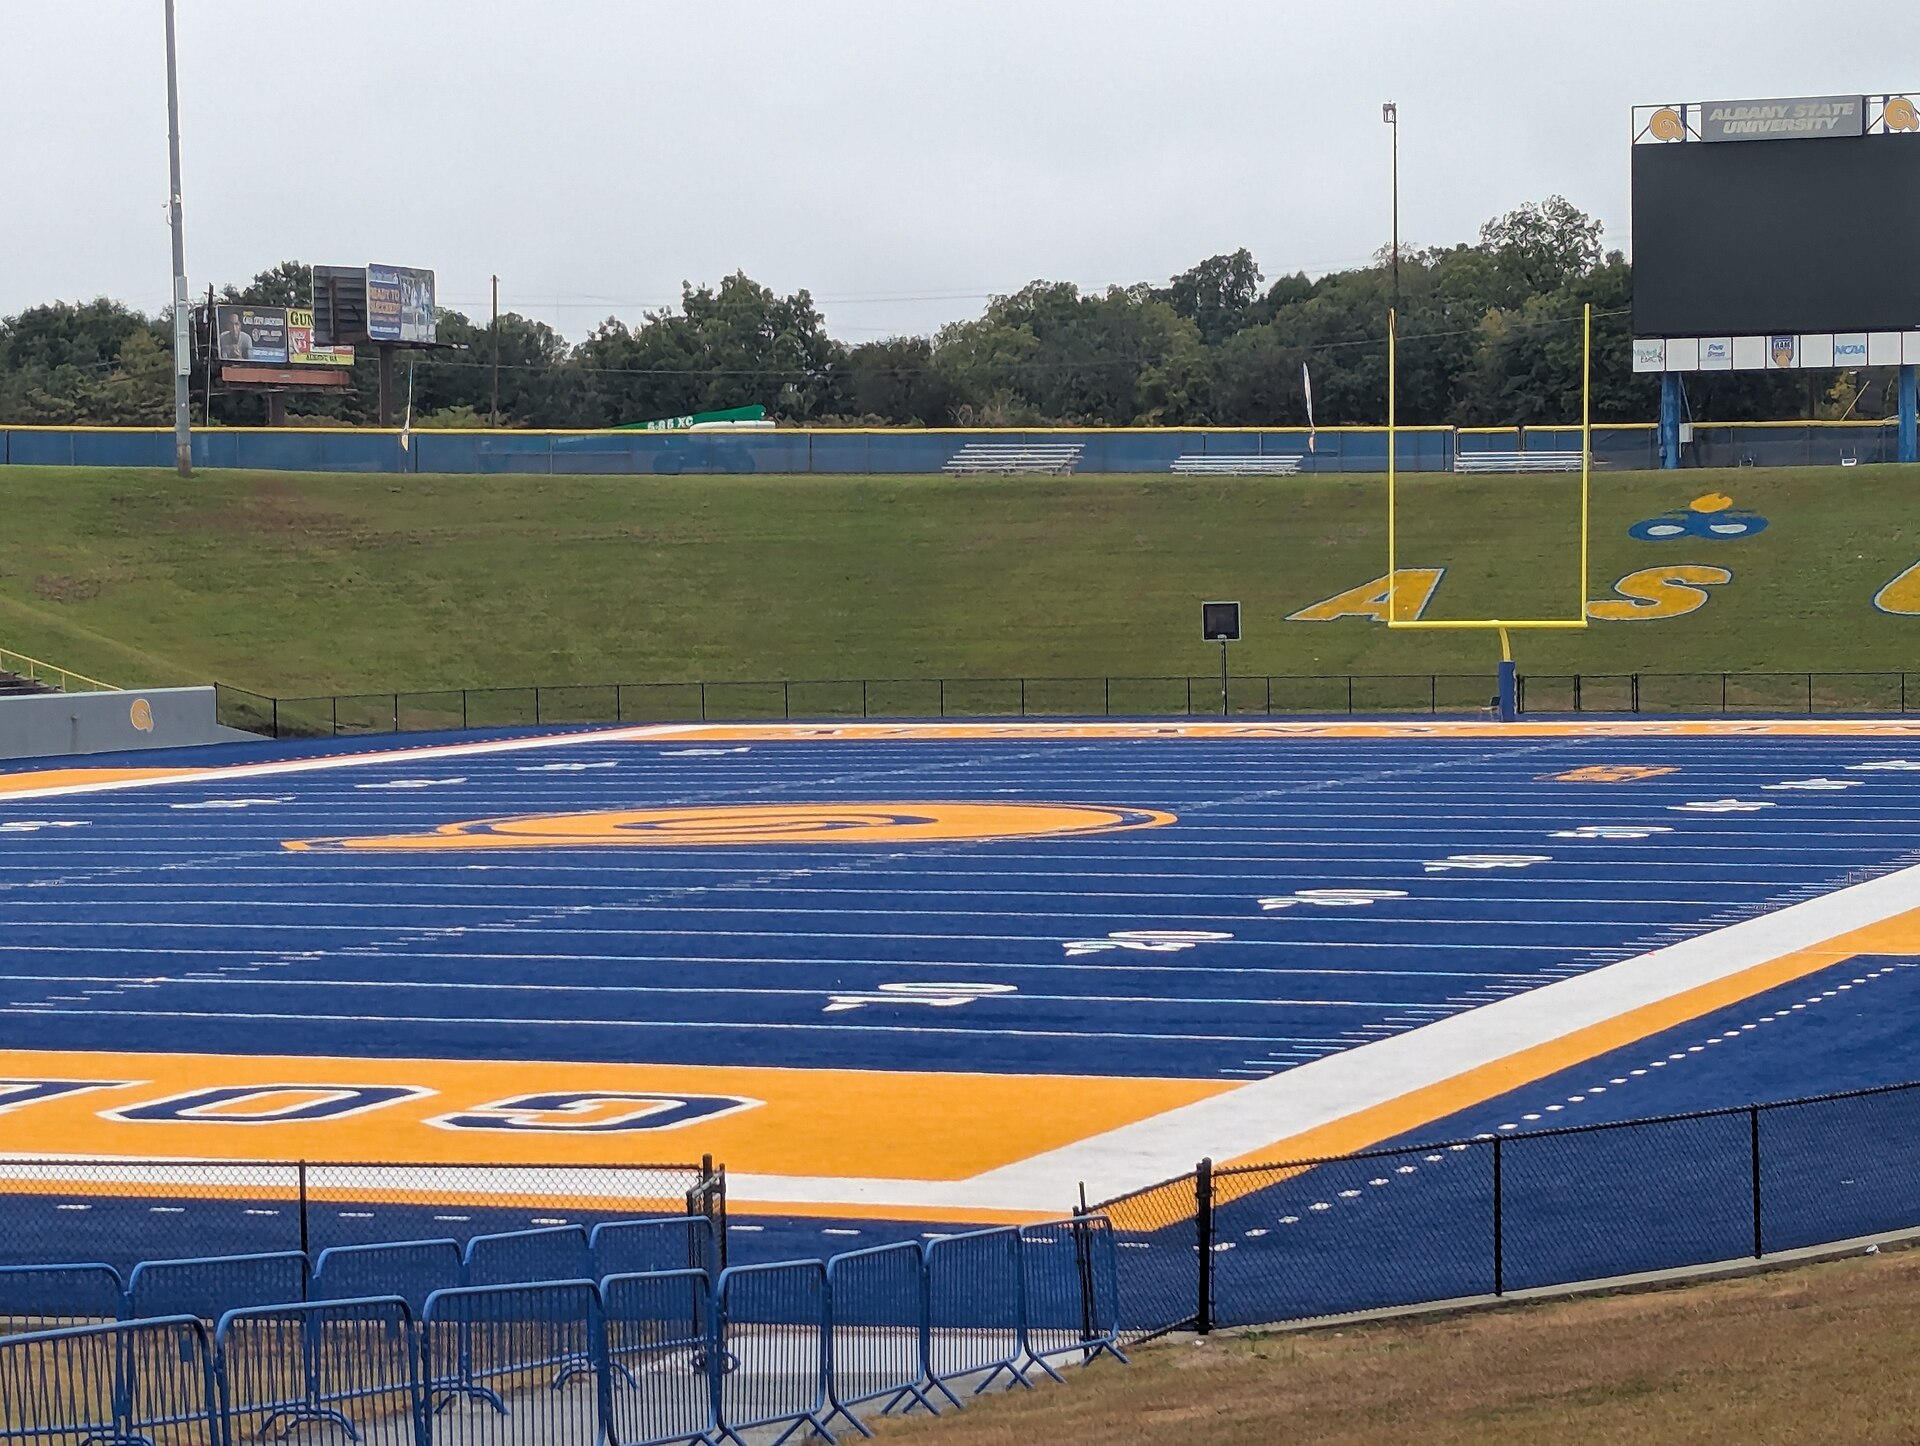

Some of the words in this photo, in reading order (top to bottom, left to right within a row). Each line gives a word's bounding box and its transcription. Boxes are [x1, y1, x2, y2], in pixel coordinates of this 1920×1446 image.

[1708, 105, 1789, 121] ALBANY
[1792, 102, 1855, 118] STATE
[1722, 116, 1840, 134] UNIVERSITY
[1835, 344, 1866, 355] NCAA
[677, 416, 694, 428] XC
[1284, 566, 1448, 622] A
